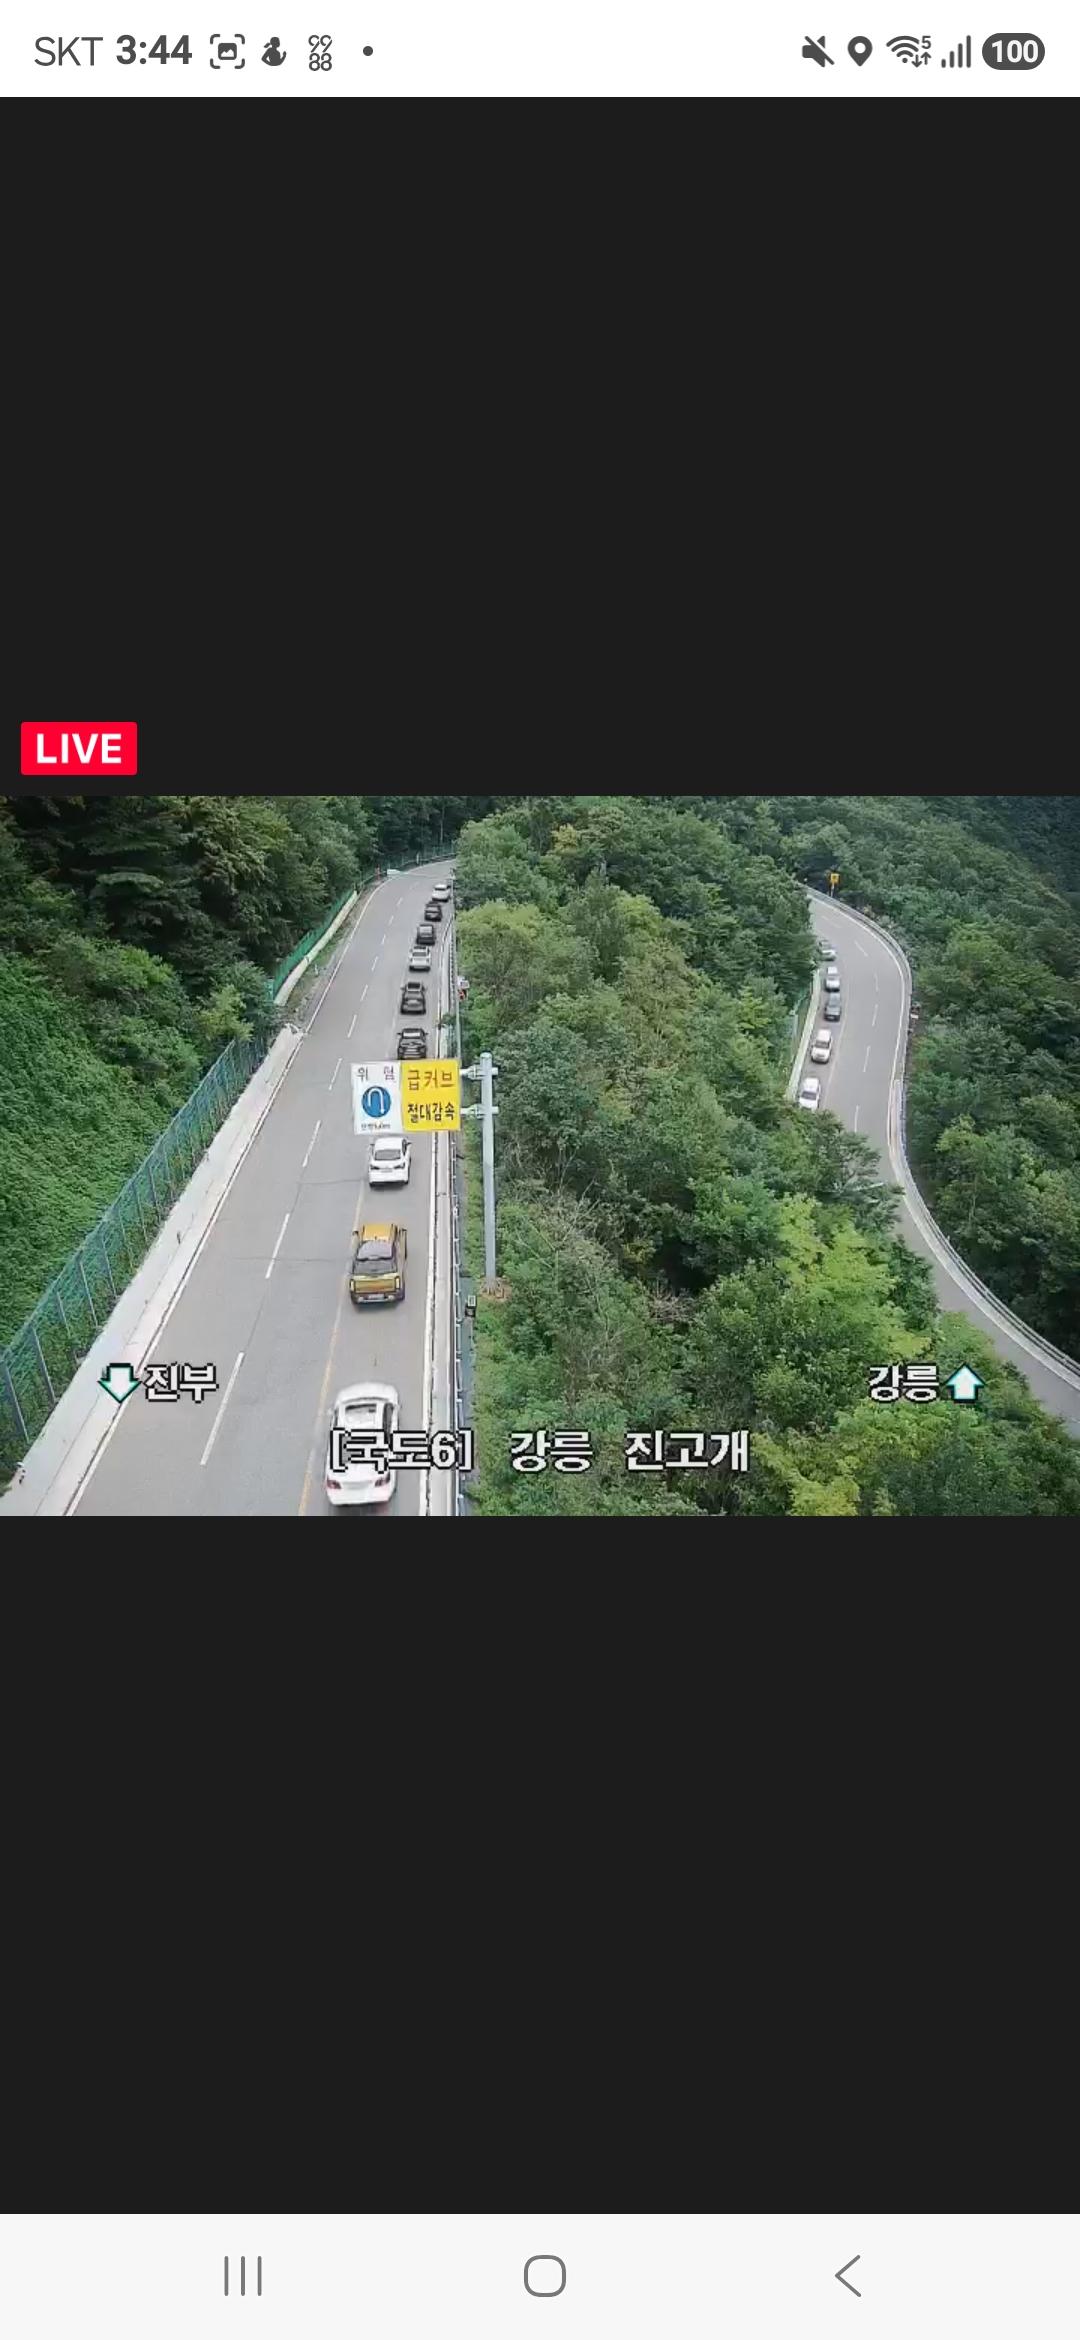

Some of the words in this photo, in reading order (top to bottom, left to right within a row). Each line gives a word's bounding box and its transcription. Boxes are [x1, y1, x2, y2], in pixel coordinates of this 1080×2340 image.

[34, 36, 104, 67] SKT
[115, 34, 193, 66] 3:44
[991, 39, 1040, 63] 100
[407, 1068, 455, 1091] 급커브
[407, 1101, 455, 1124] 절대감속
